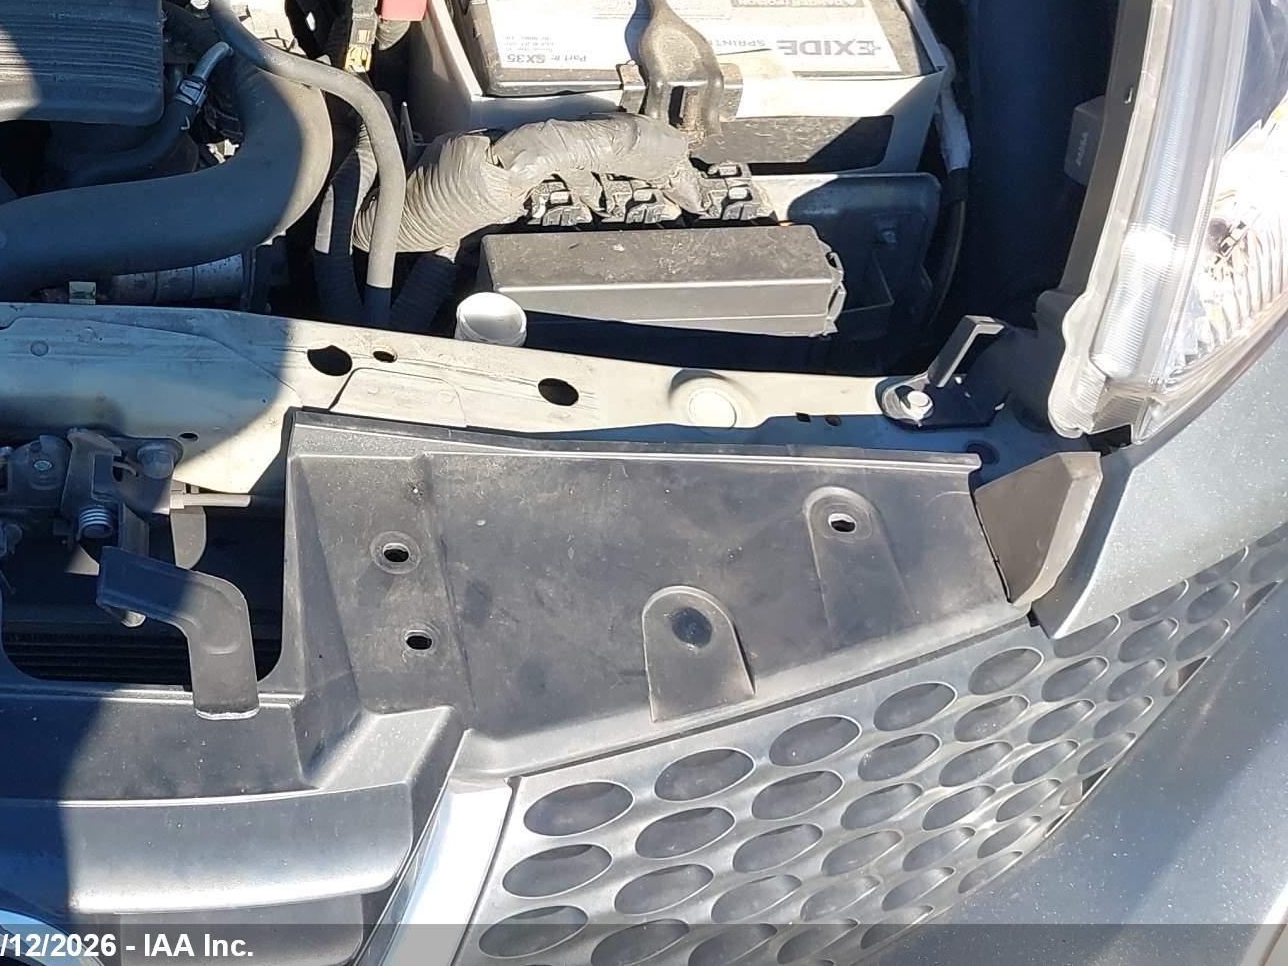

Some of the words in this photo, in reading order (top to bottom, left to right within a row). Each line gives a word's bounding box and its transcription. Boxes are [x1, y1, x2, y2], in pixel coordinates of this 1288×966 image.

[776, 40, 881, 56] EXIDE
[506, 54, 546, 63] SX35
[565, 54, 587, 62] Part
